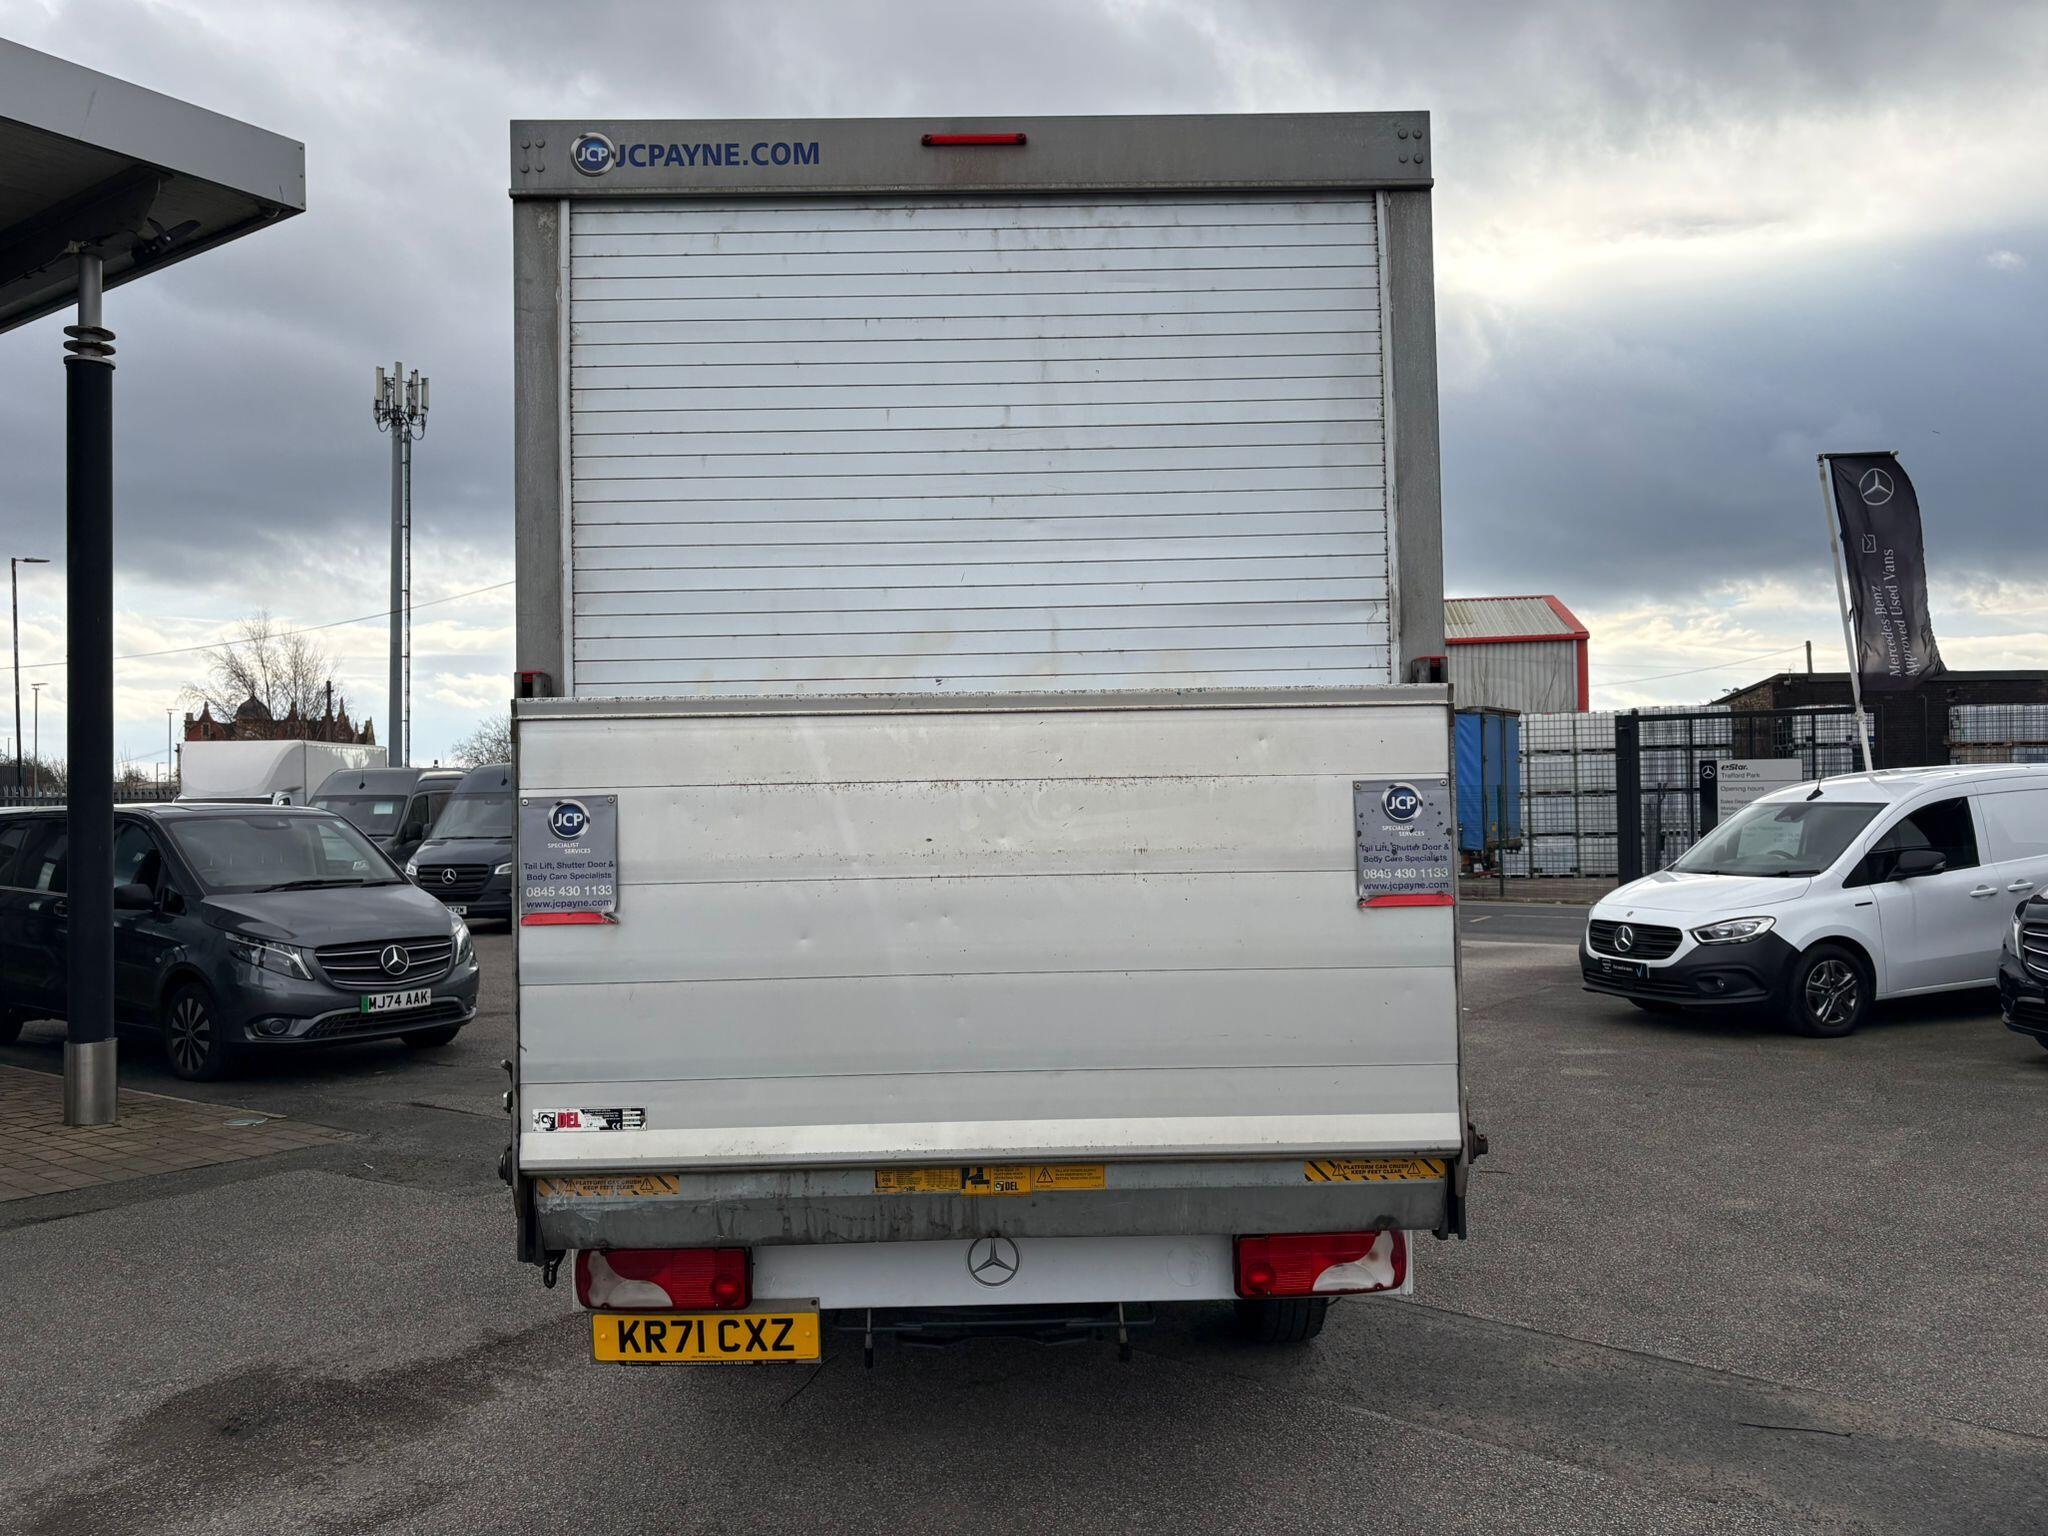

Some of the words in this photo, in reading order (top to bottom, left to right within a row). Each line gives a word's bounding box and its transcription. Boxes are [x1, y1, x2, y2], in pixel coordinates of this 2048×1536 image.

[578, 147, 609, 162] JCP
[616, 142, 820, 167] JCPAYNE.COM
[1883, 548, 1895, 583] Vans
[1886, 584, 1904, 616] Used
[1872, 585, 1901, 677] Mercedes-Benz
[1894, 619, 1920, 677] Approved
[1389, 796, 1416, 810] JCP
[555, 813, 583, 827] JCP
[1361, 844, 1373, 852] Tail
[1391, 843, 1419, 851] Shutter
[1422, 843, 1441, 851] Door
[1363, 855, 1383, 864] Body
[1384, 854, 1402, 862] Care
[1404, 852, 1448, 862] Specialists
[523, 862, 538, 870] Tail
[539, 862, 555, 871] Lift,
[556, 861, 585, 869] Shutter
[587, 860, 607, 868] Door
[608, 860, 614, 868] &
[526, 873, 547, 882] Body
[569, 871, 612, 880] Specialists
[1363, 869, 1392, 880] 0845
[1394, 868, 1417, 879] 430
[1420, 867, 1449, 878] 1133
[526, 887, 556, 897] 0845
[558, 885, 580, 896] 430
[584, 884, 613, 896] 1133
[1363, 881, 1449, 891] www.jcpayne.com
[526, 898, 612, 909] www.jcpayne.com
[368, 994, 402, 1010] MJ74
[405, 991, 428, 1006] AAK
[557, 1112, 581, 1128] DEL
[1005, 1182, 1019, 1191] DEL
[618, 1320, 705, 1353] KR71
[718, 1318, 795, 1352] CXZ
